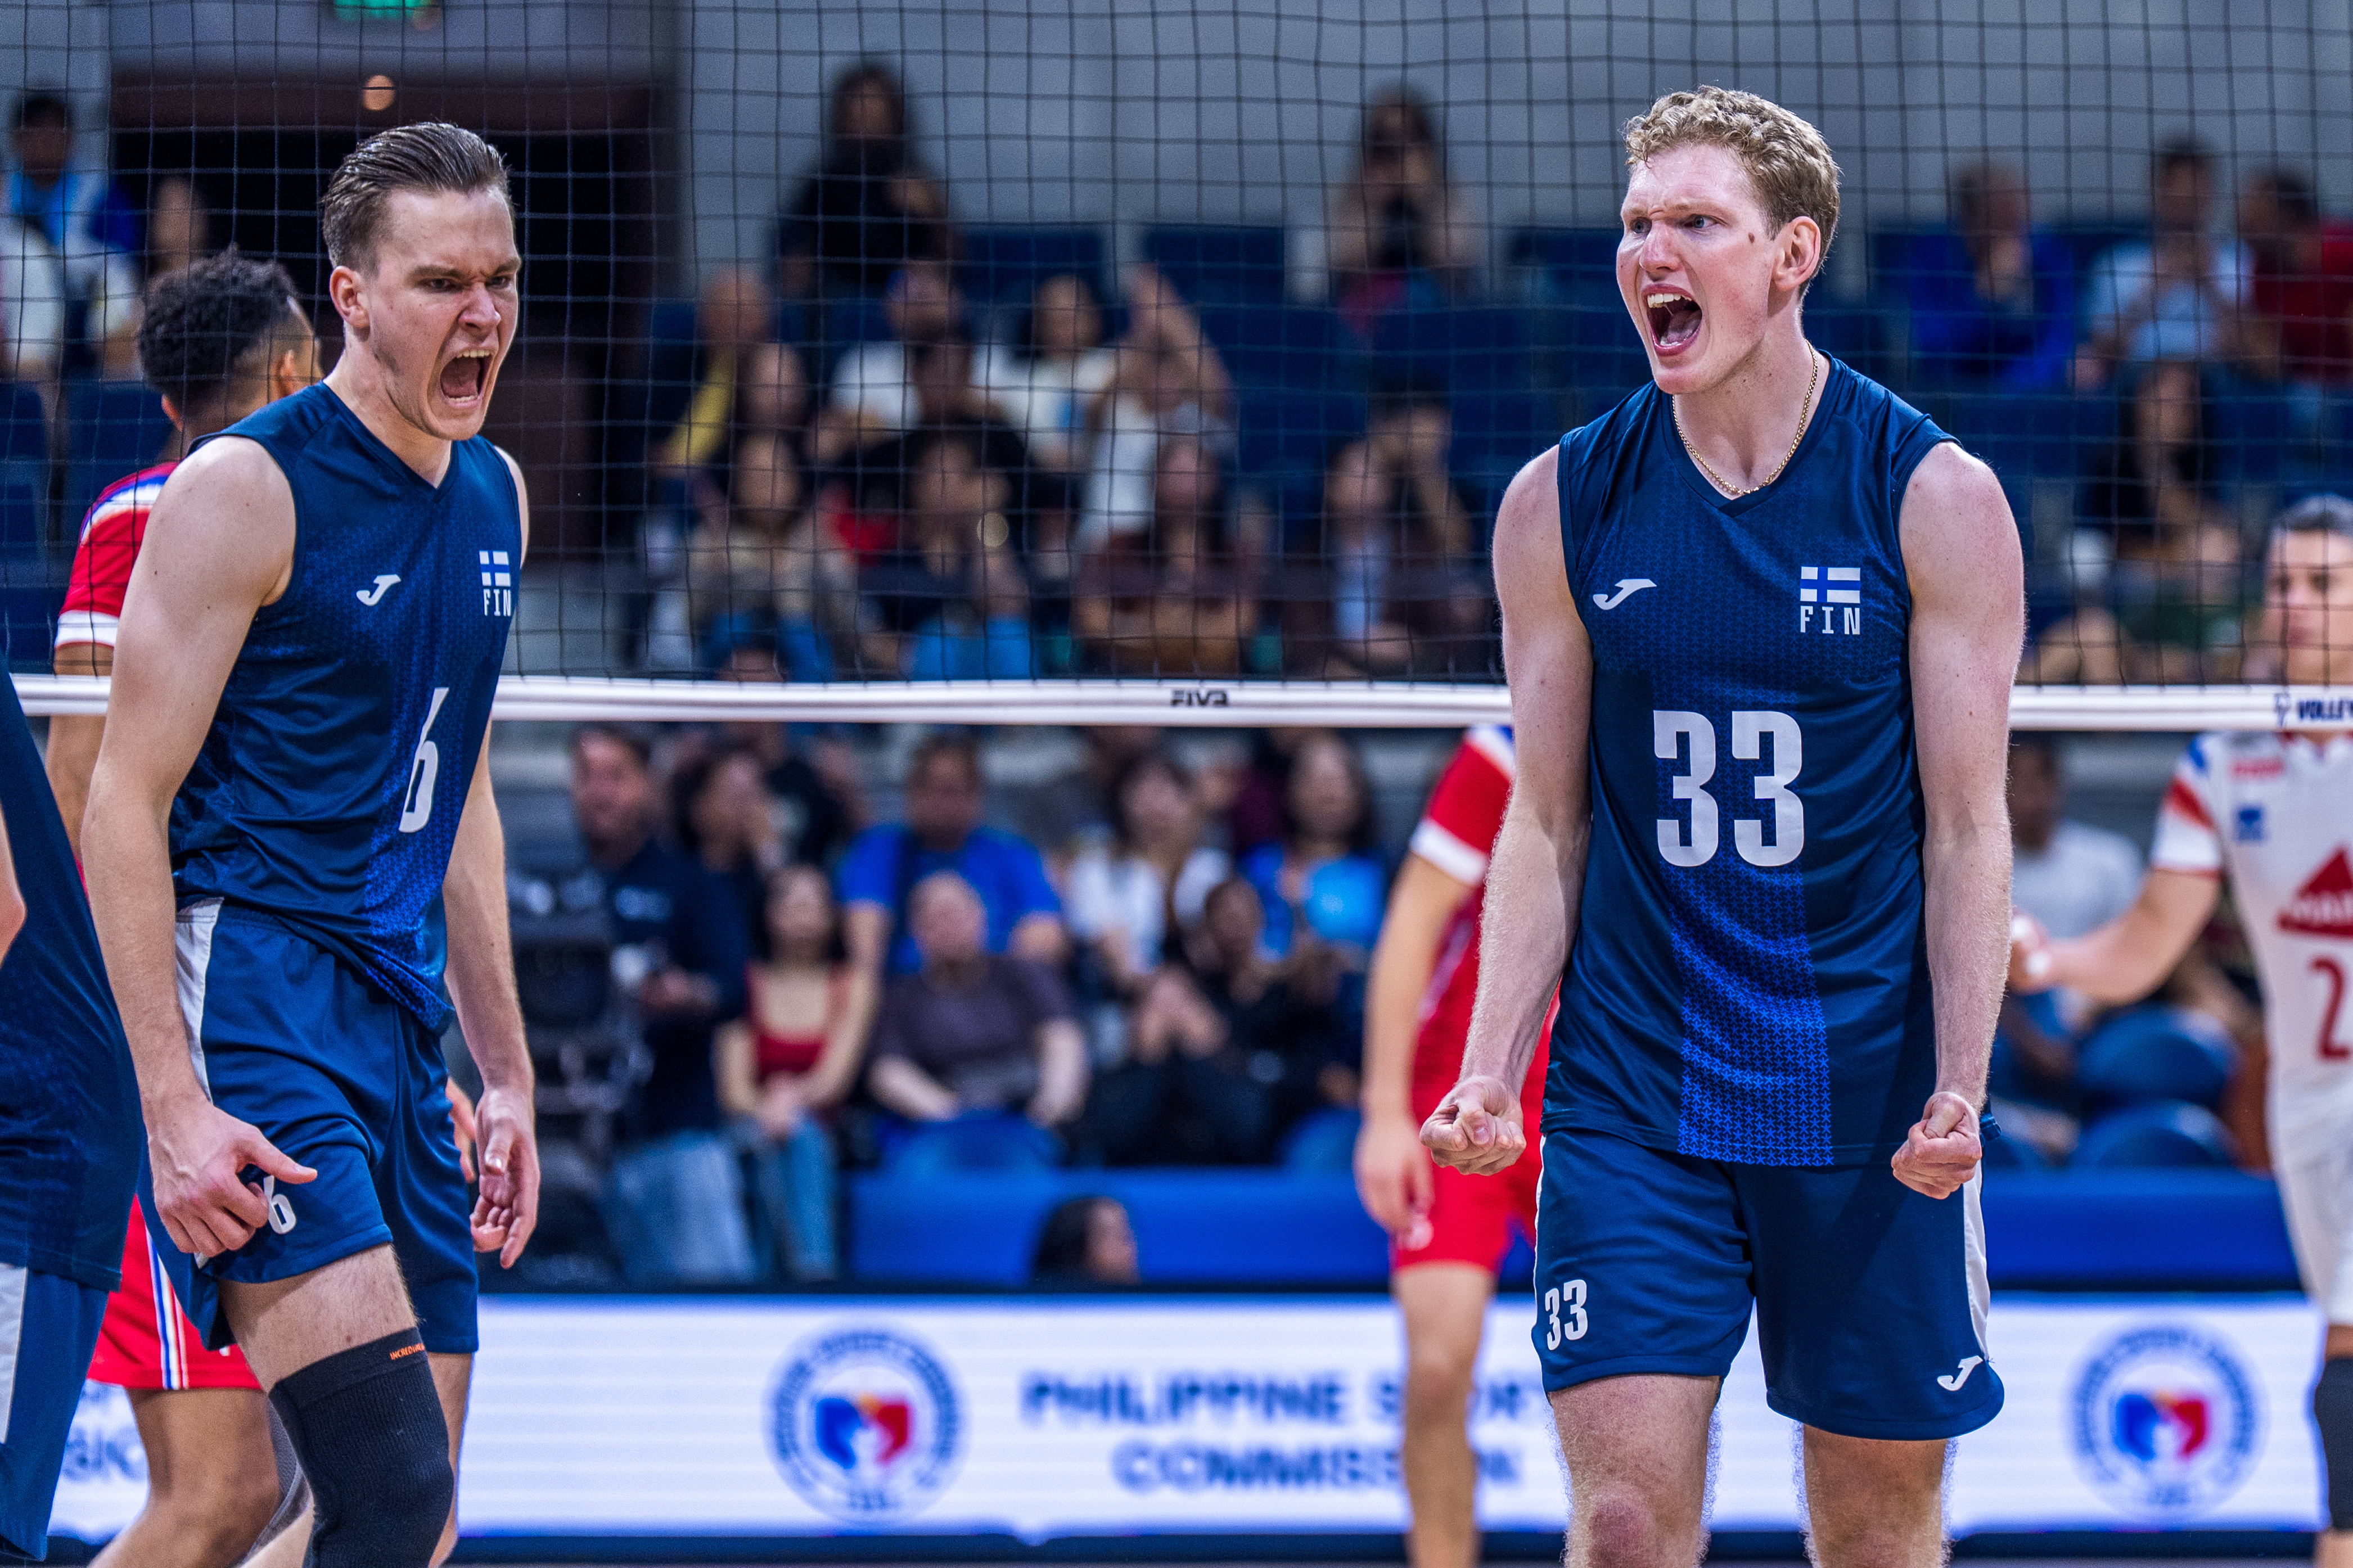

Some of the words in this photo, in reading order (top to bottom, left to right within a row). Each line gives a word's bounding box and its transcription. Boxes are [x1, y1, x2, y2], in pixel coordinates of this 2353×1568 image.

[484, 589, 511, 616] FIN
[1800, 605, 1860, 635] FIN
[1171, 690, 1227, 707] FIVB
[399, 687, 449, 833] 6
[1653, 710, 1804, 867] 33
[263, 1175, 296, 1235] 6
[1545, 1279, 1588, 1350] 33
[1022, 1372, 1342, 1422] PHILIPPINE
